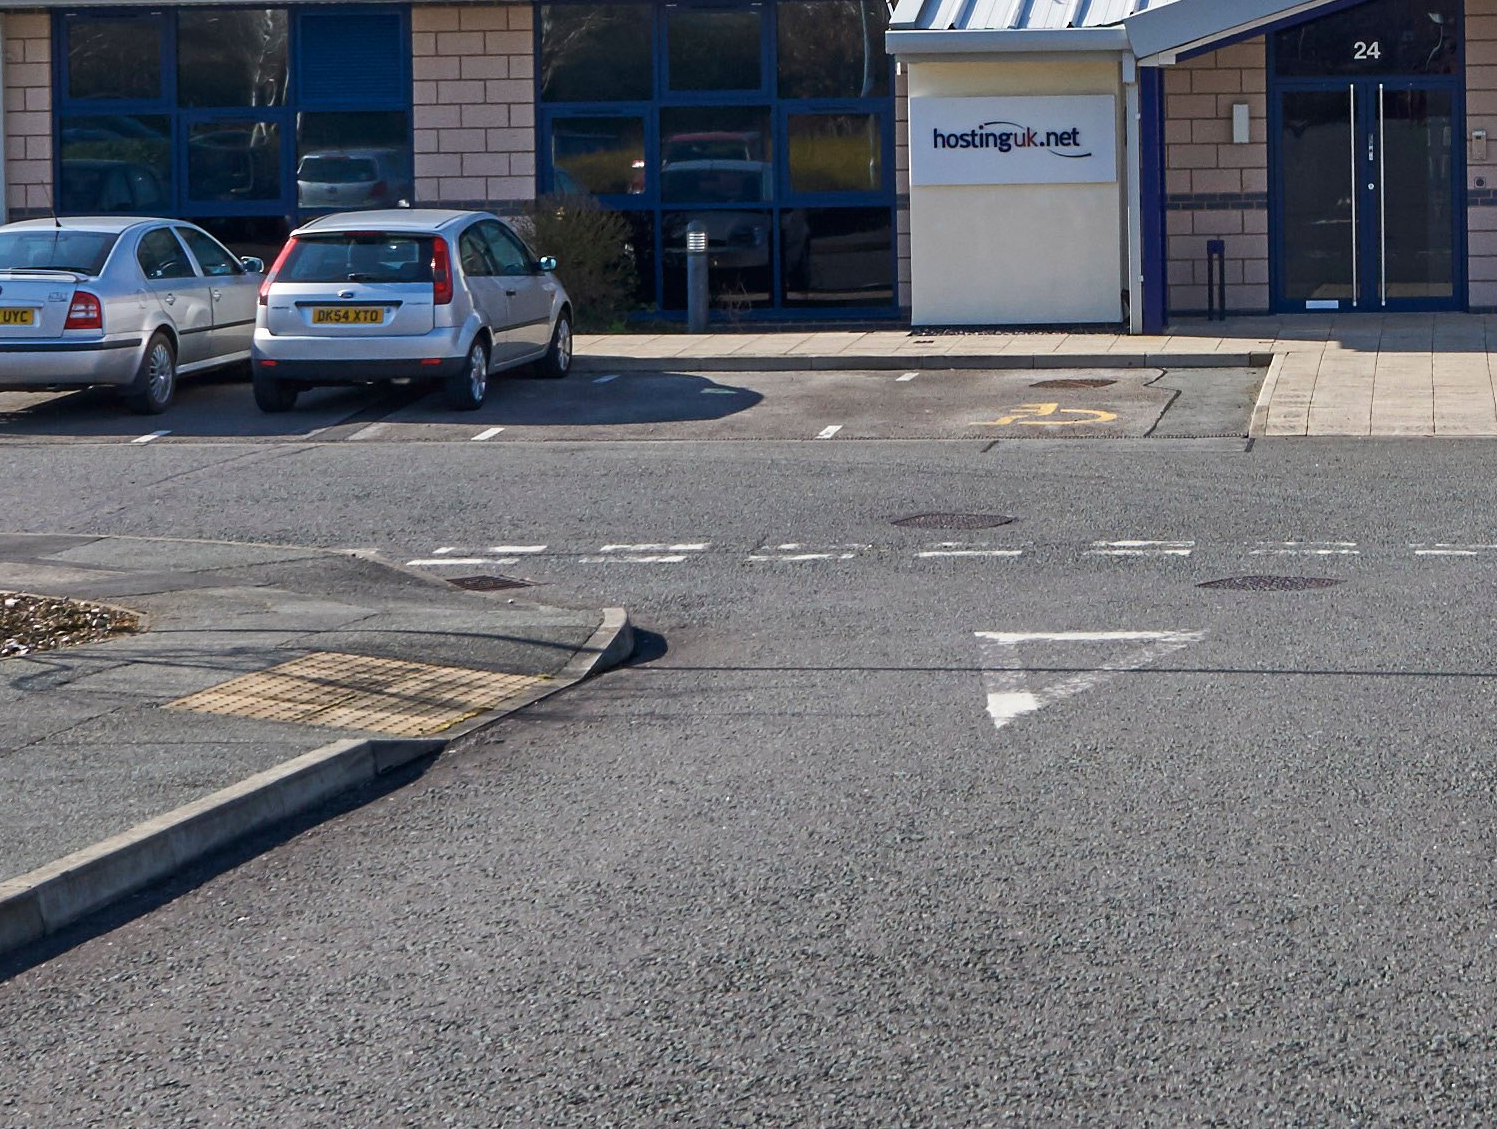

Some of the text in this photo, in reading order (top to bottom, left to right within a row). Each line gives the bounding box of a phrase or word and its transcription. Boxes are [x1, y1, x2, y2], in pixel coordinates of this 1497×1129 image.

[1353, 41, 1381, 60] 24
[933, 124, 1080, 153] hostinguk.net
[3, 311, 28, 323] UYC
[317, 308, 378, 322] DK54 XTO
